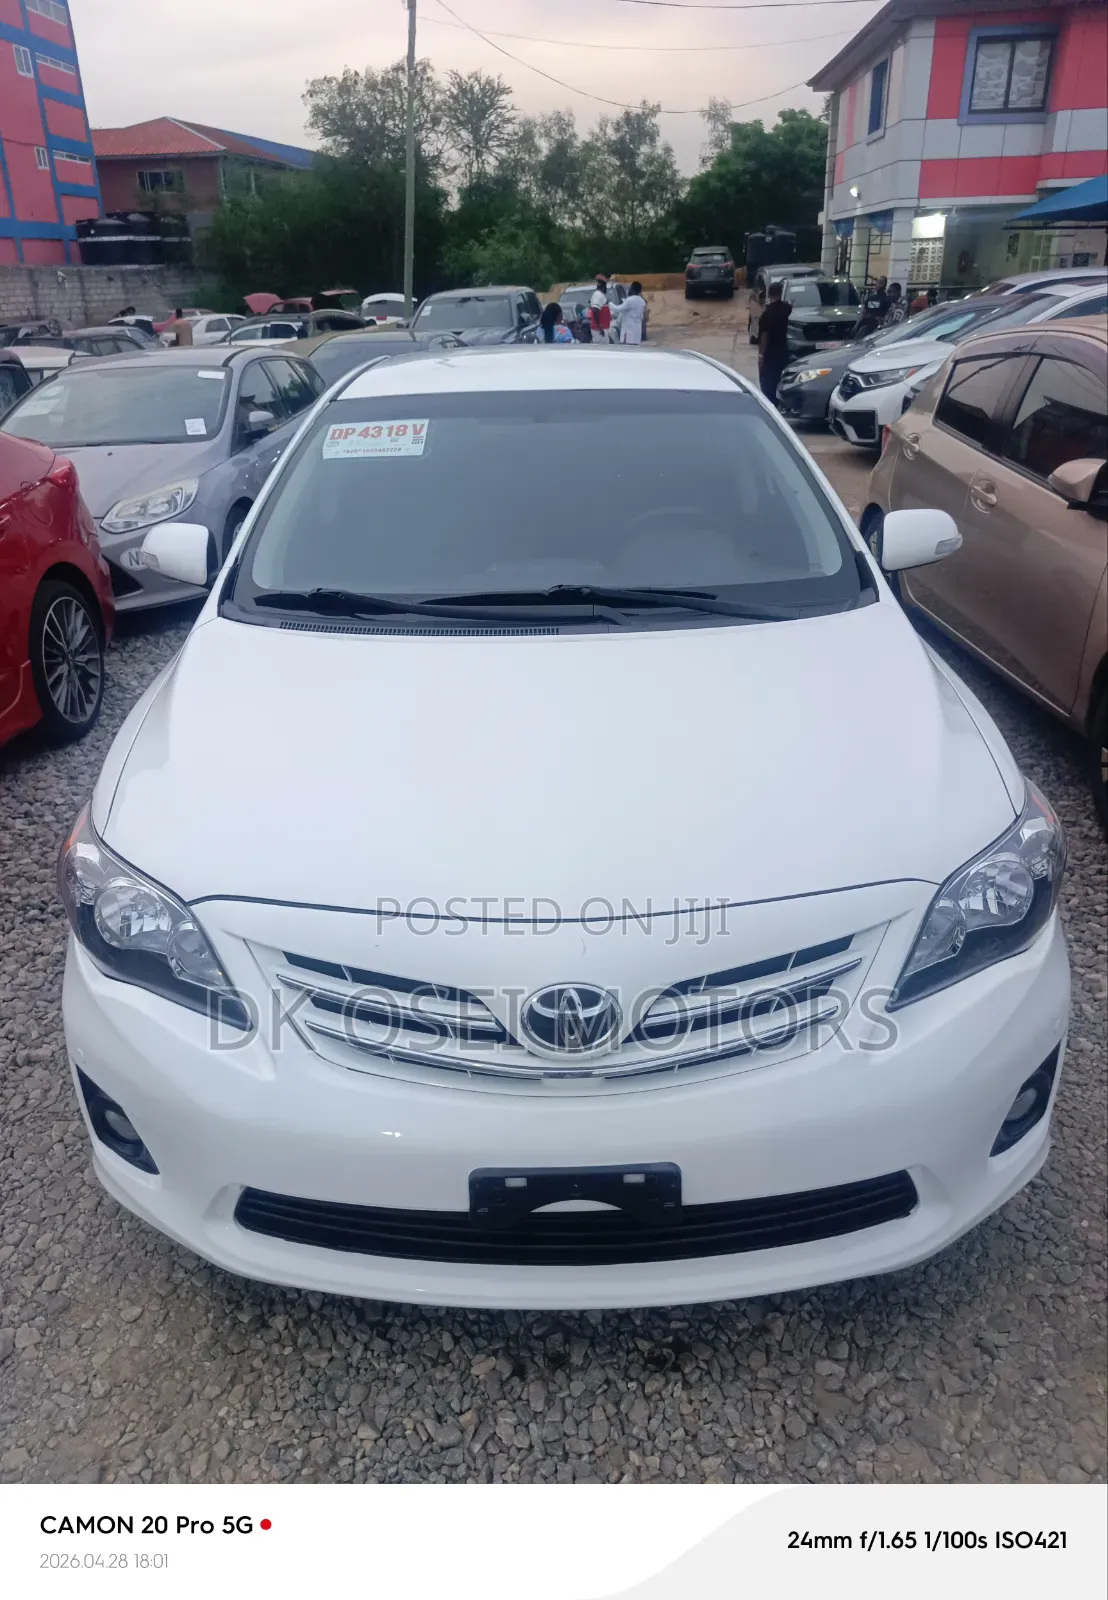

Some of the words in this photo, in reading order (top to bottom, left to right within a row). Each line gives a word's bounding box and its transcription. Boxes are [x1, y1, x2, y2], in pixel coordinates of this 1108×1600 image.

[329, 427, 357, 441] DP
[357, 424, 408, 439] 4318
[412, 423, 425, 436] V
